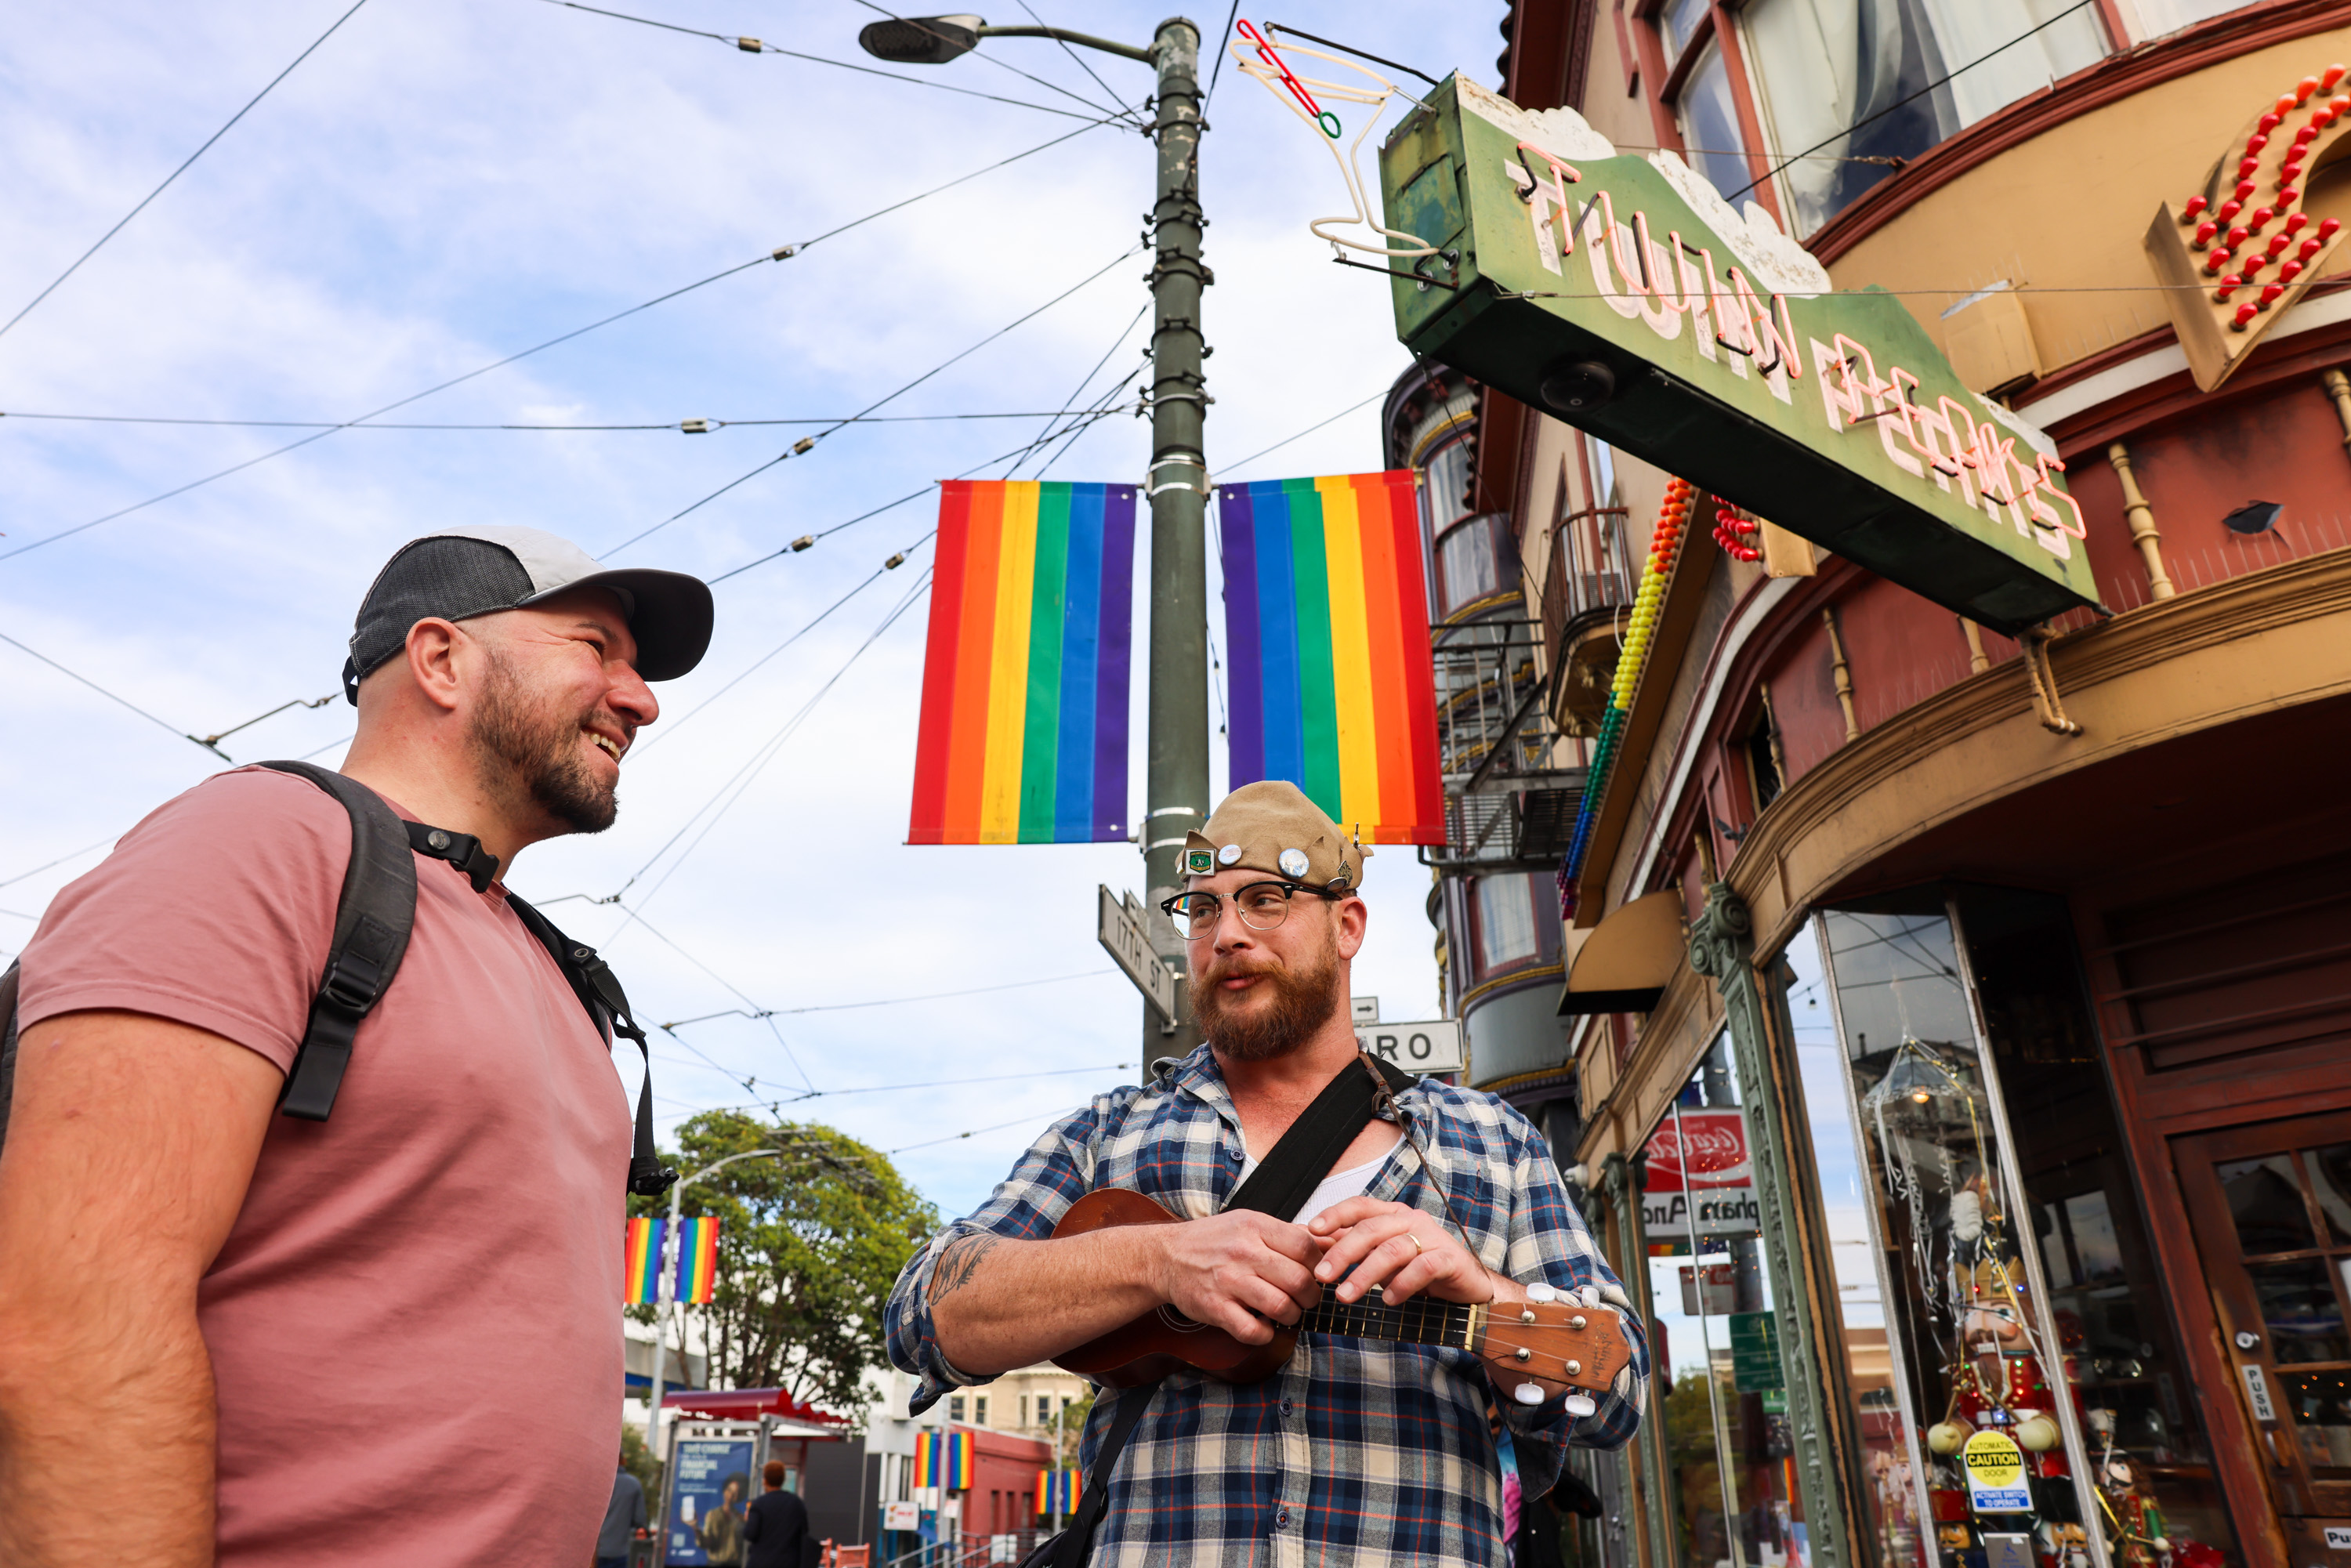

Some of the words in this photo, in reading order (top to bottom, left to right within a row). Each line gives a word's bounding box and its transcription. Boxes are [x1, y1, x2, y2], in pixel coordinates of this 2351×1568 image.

[1505, 142, 1801, 405] TWIN
[1809, 332, 2087, 559] PEAKS
[1118, 915, 1142, 971] 17TH
[1150, 959, 1161, 994] ST
[1376, 1033, 1431, 1060] RO
[2248, 1370, 2269, 1416] PUSH
[1967, 1453, 2020, 1466] CAUTION
[2327, 1532, 2351, 1543] Pu
